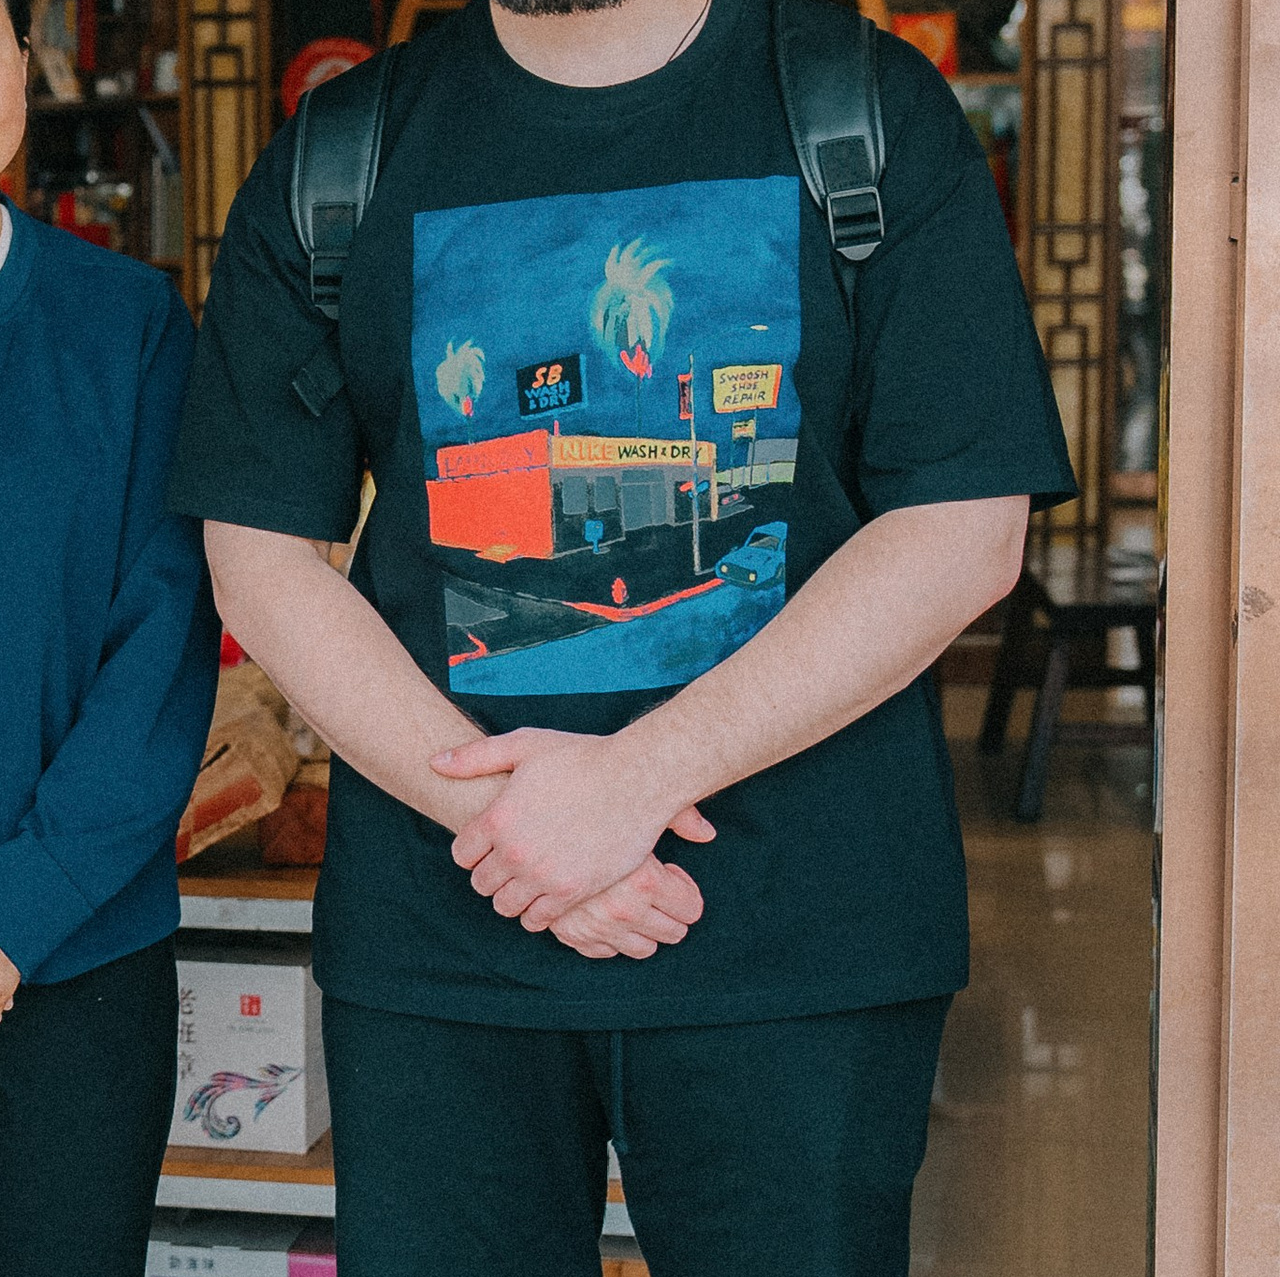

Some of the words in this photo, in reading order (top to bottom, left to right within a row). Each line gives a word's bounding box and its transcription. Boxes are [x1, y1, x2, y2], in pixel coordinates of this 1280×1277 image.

[532, 364, 563, 388] SB
[720, 370, 769, 384] SWOOSH
[524, 380, 570, 399] WASH
[731, 381, 757, 393] SHOE
[538, 394, 570, 409] DRY
[723, 391, 766, 406] REPAIR
[560, 443, 613, 461] NIKE
[618, 445, 658, 460] WASH
